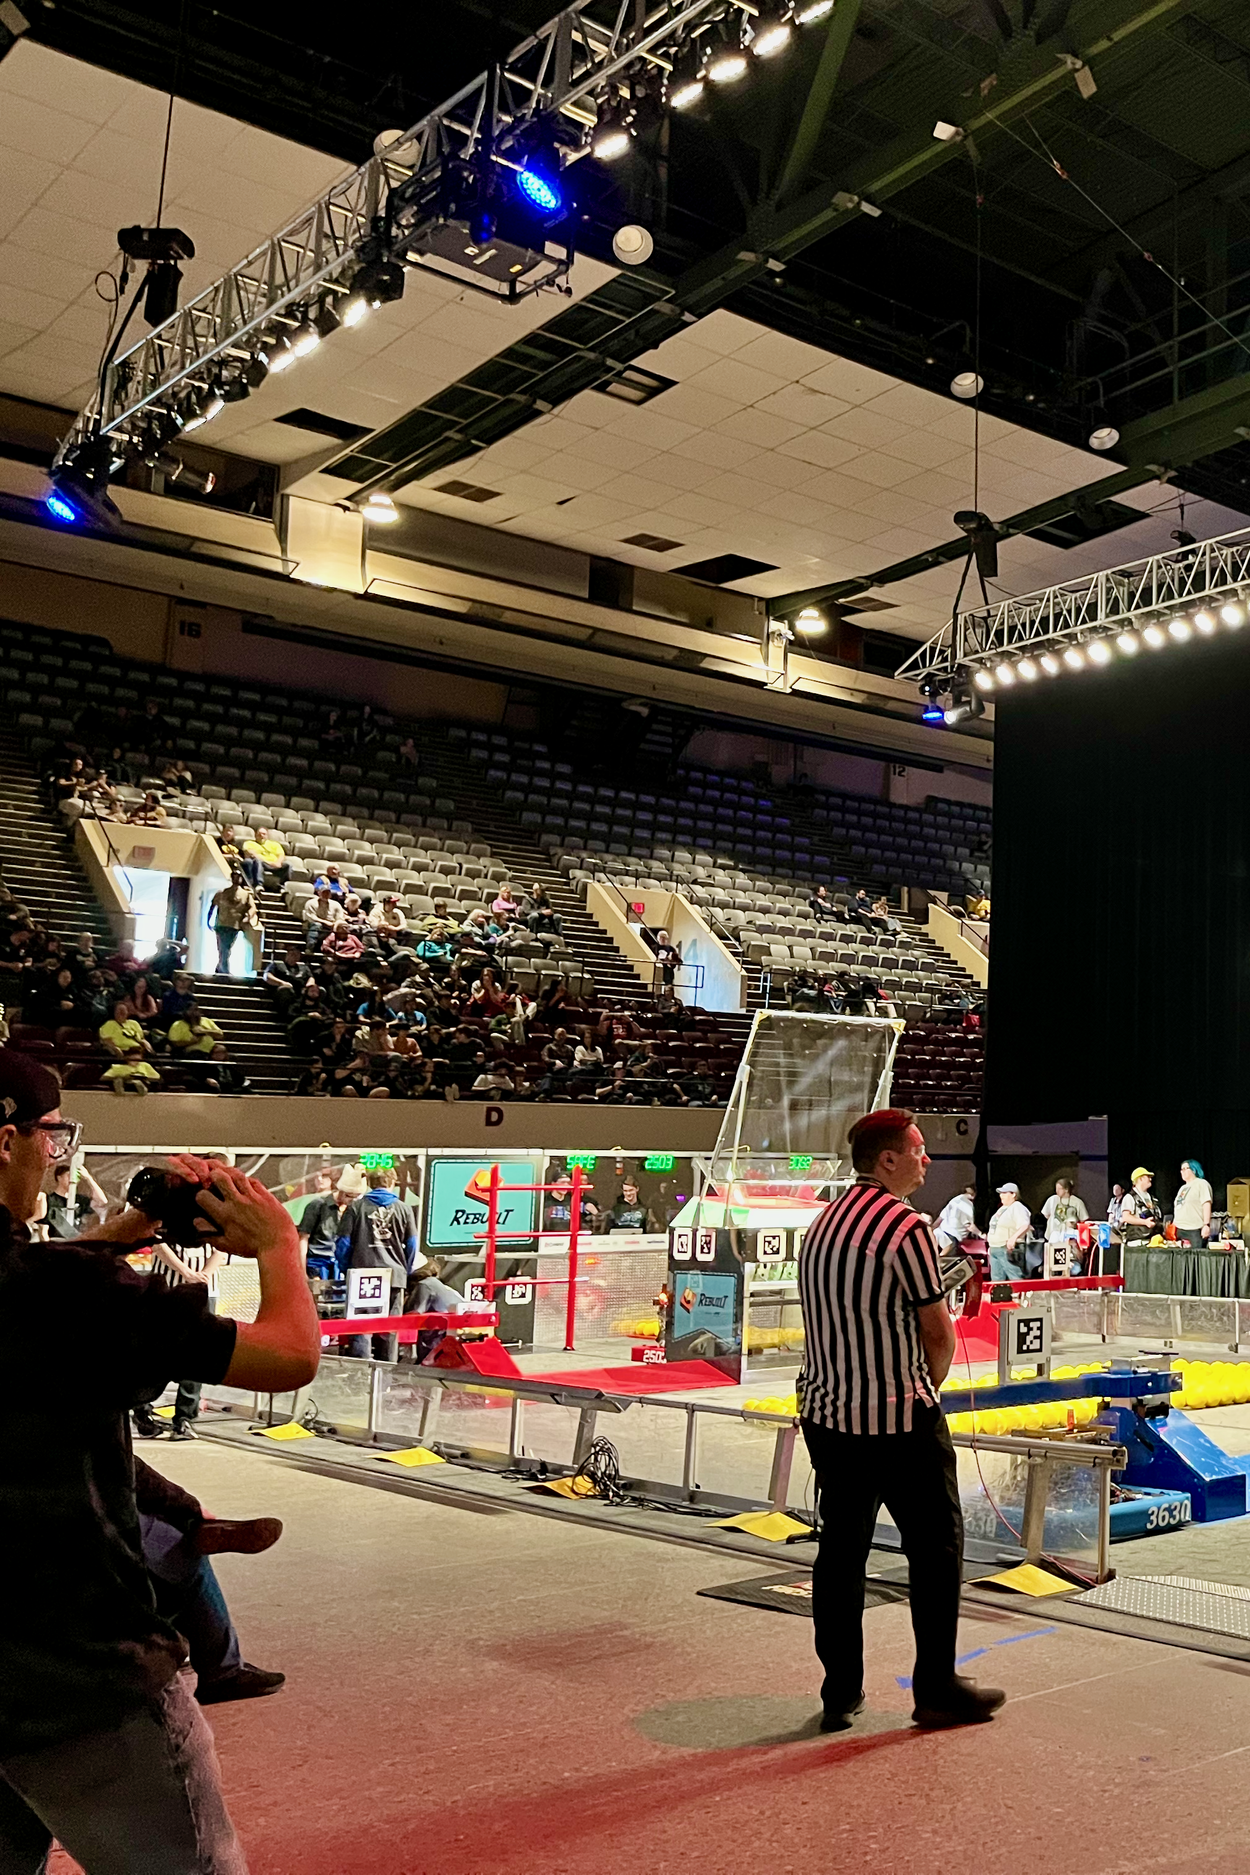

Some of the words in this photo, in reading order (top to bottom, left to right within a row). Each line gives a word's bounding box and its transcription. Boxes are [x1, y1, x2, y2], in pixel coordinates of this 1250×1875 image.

[179, 620, 201, 638] 16
[892, 764, 906, 778] 12
[485, 1106, 504, 1126] D
[956, 1118, 969, 1136] C
[644, 1154, 674, 1169] 2503
[449, 1208, 515, 1227] REBULT
[1146, 1499, 1192, 1530] 3630
